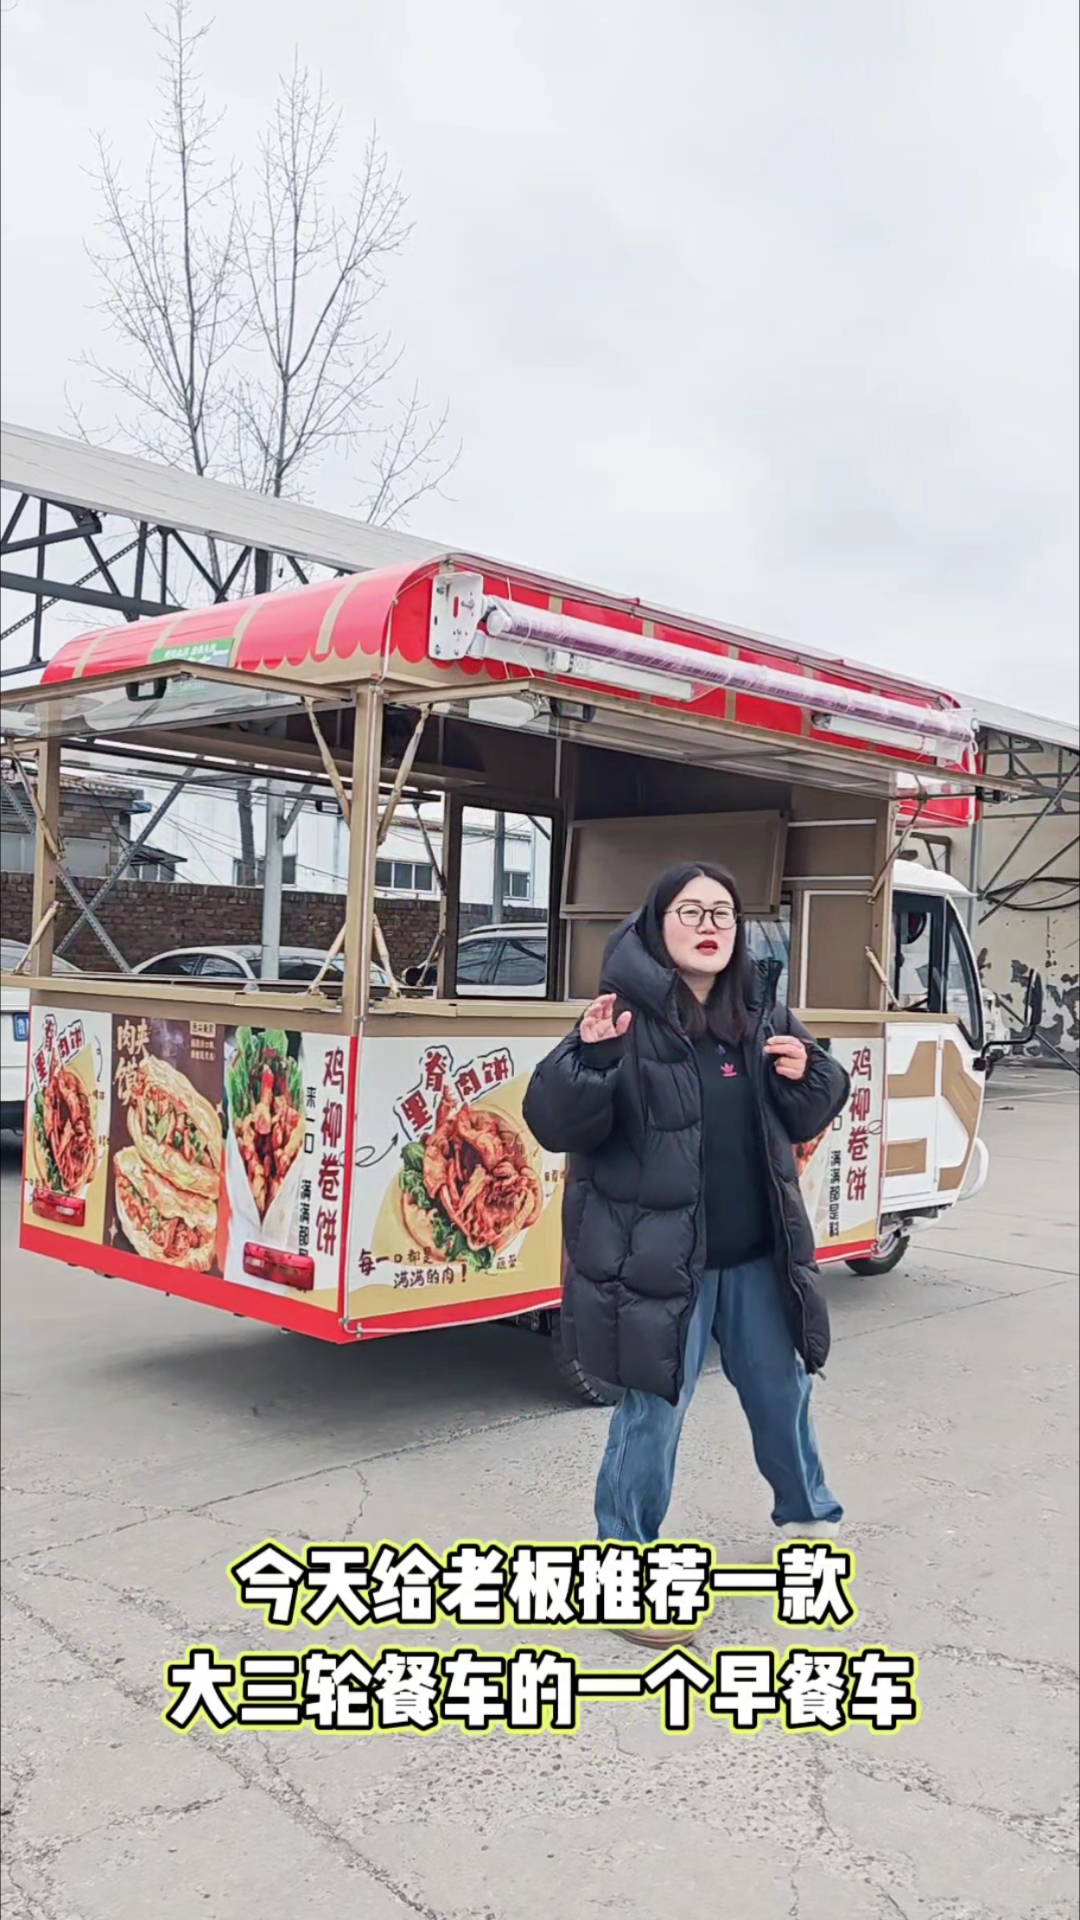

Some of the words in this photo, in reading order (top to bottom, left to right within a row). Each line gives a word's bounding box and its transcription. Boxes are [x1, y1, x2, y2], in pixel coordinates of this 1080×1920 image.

[304, 1087, 317, 1154] 来一口
[401, 1051, 509, 1132] 里脊肉饼
[846, 1046, 872, 1202] 鸡柳卷饼
[316, 1046, 345, 1256] 鸡柳卷饼
[358, 1247, 434, 1276] 每一口都是
